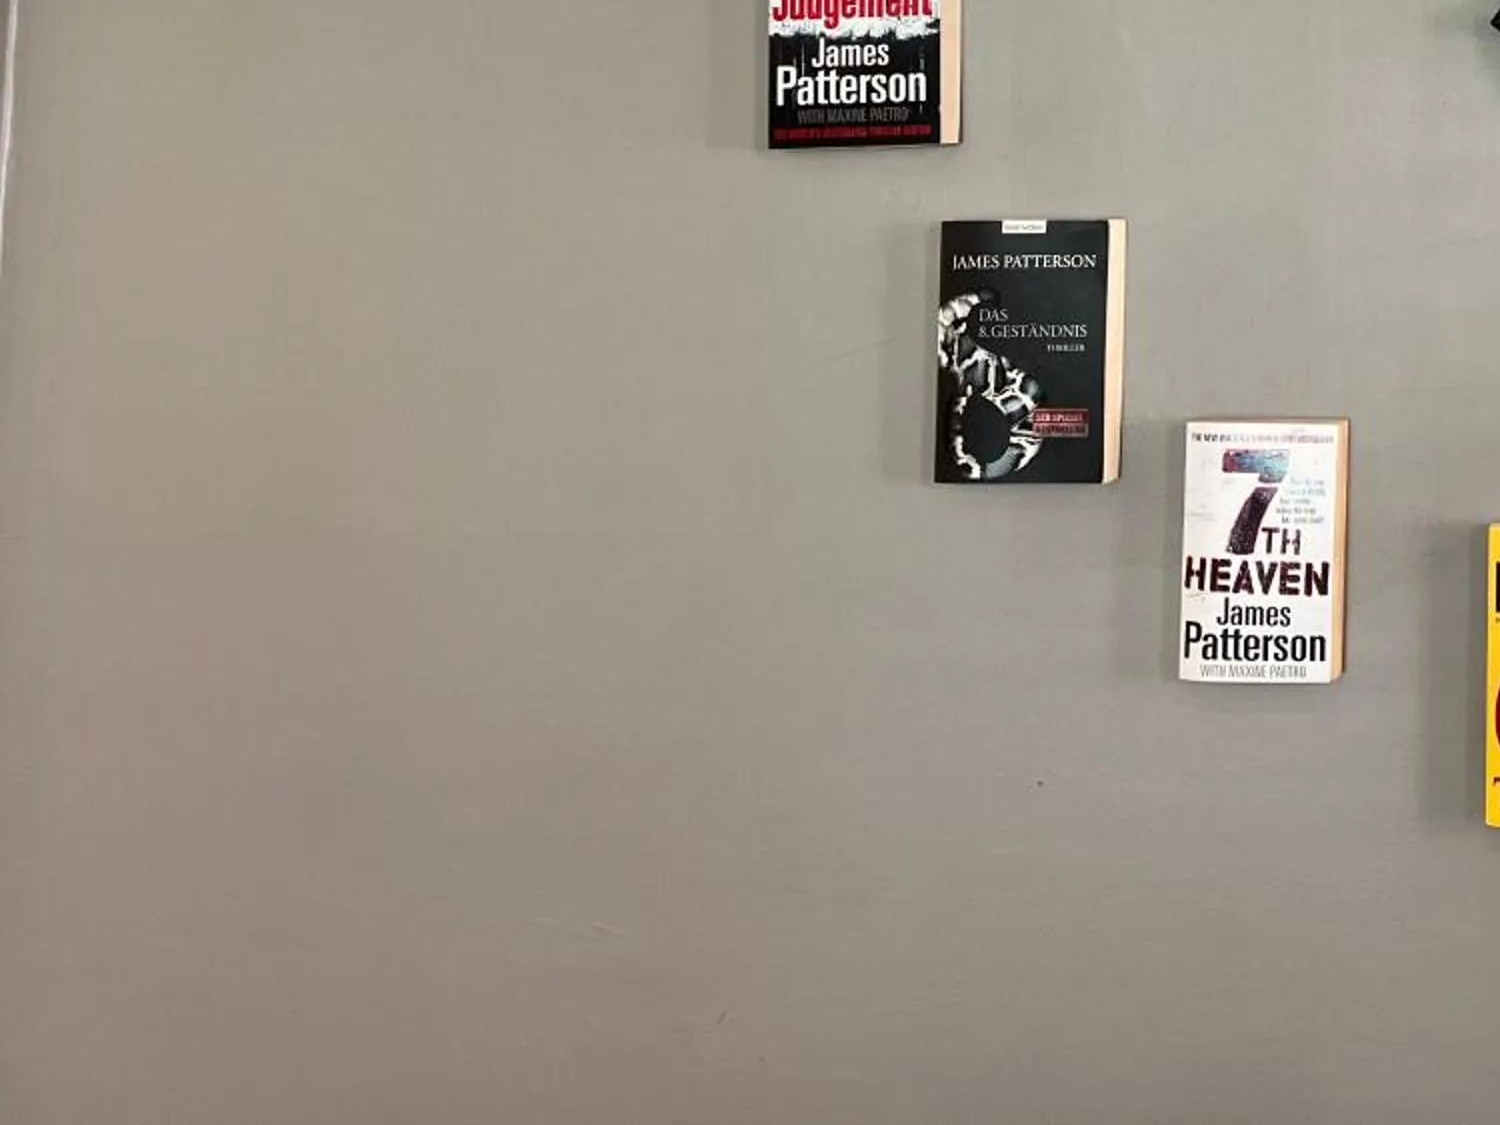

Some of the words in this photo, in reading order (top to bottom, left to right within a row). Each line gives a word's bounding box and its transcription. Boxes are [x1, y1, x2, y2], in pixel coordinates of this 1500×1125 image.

[811, 36, 889, 68] James
[776, 65, 927, 107] Patterson
[953, 254, 1000, 270] JAMES
[1003, 254, 1096, 269] PATTERSON
[979, 308, 1009, 322] DAS
[1184, 556, 1330, 597] HEAVEN
[1216, 597, 1291, 627] James
[1184, 620, 1326, 662] Patterson
[1200, 665, 1225, 678] WITH
